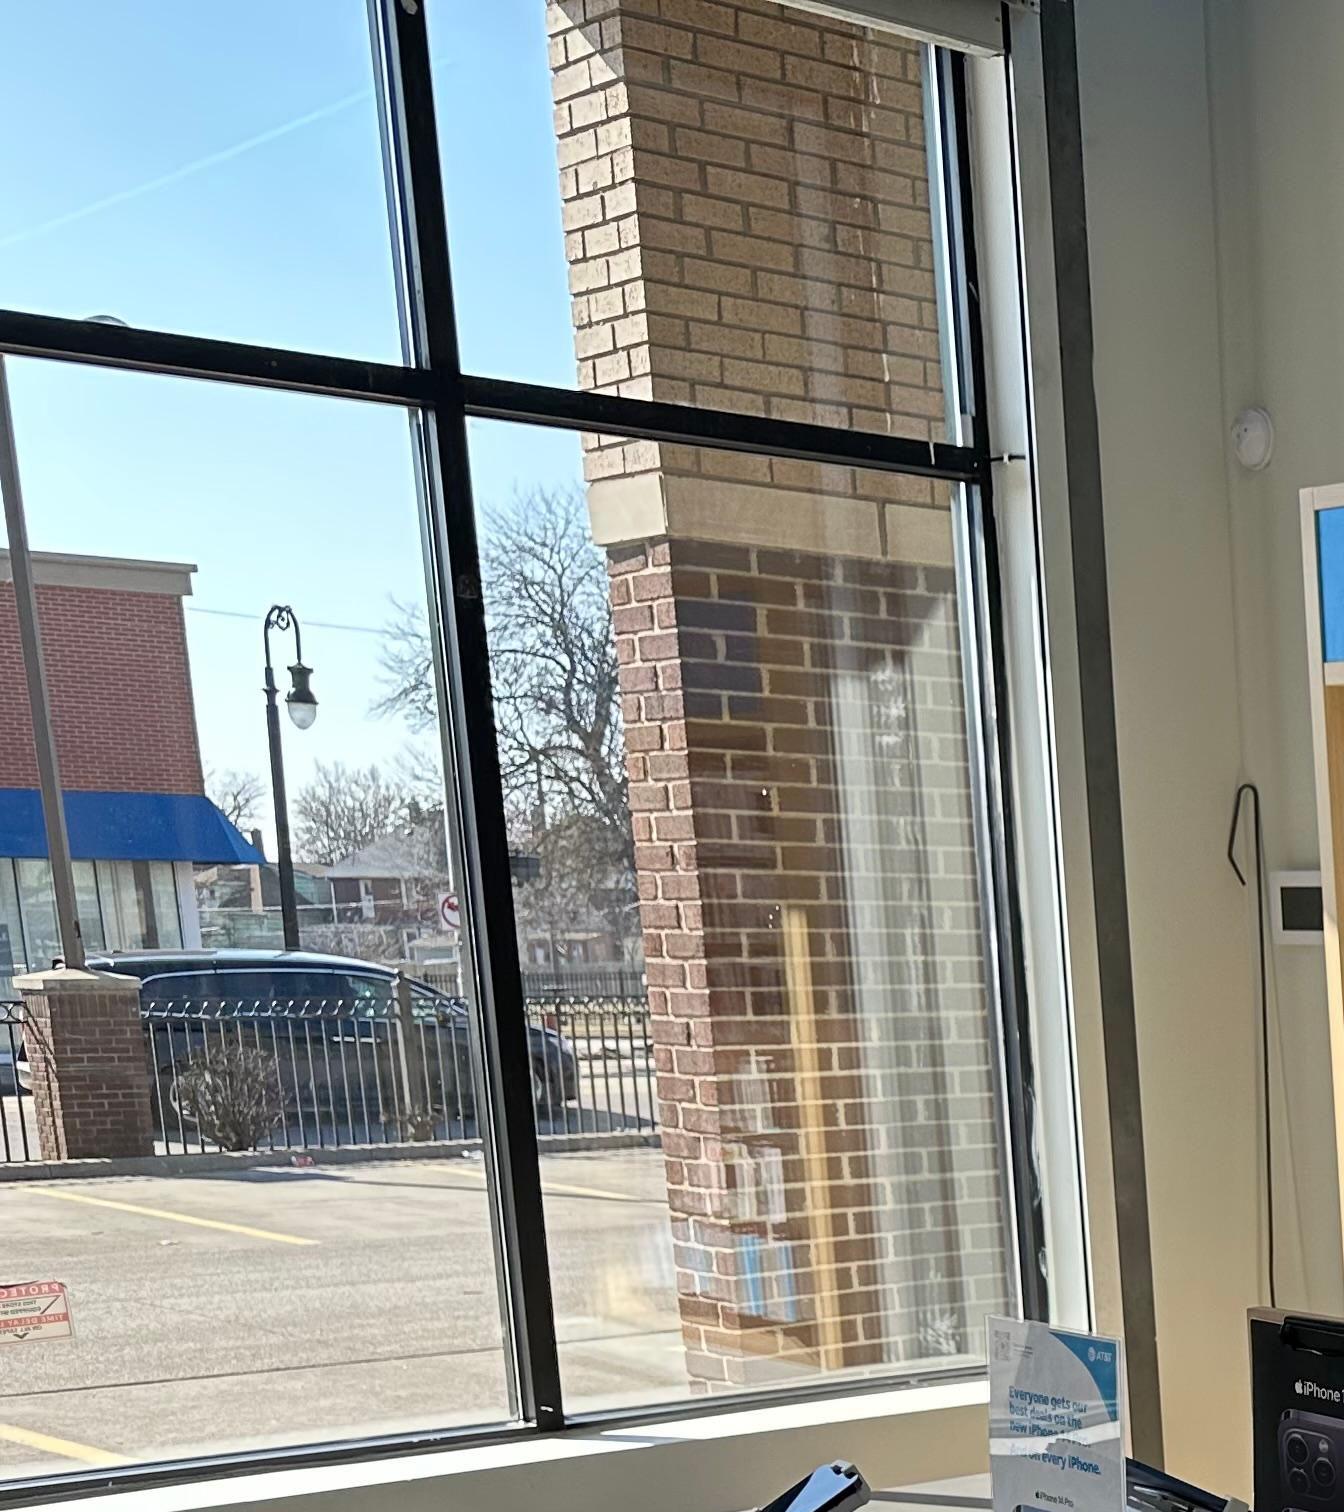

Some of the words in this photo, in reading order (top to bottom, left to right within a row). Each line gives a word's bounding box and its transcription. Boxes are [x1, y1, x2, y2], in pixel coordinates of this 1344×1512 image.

[1008, 1385, 1049, 1407] Everyone
[1051, 1396, 1070, 1410] gets
[1303, 1381, 1341, 1403] iPhone
[1041, 1452, 1067, 1471] every
